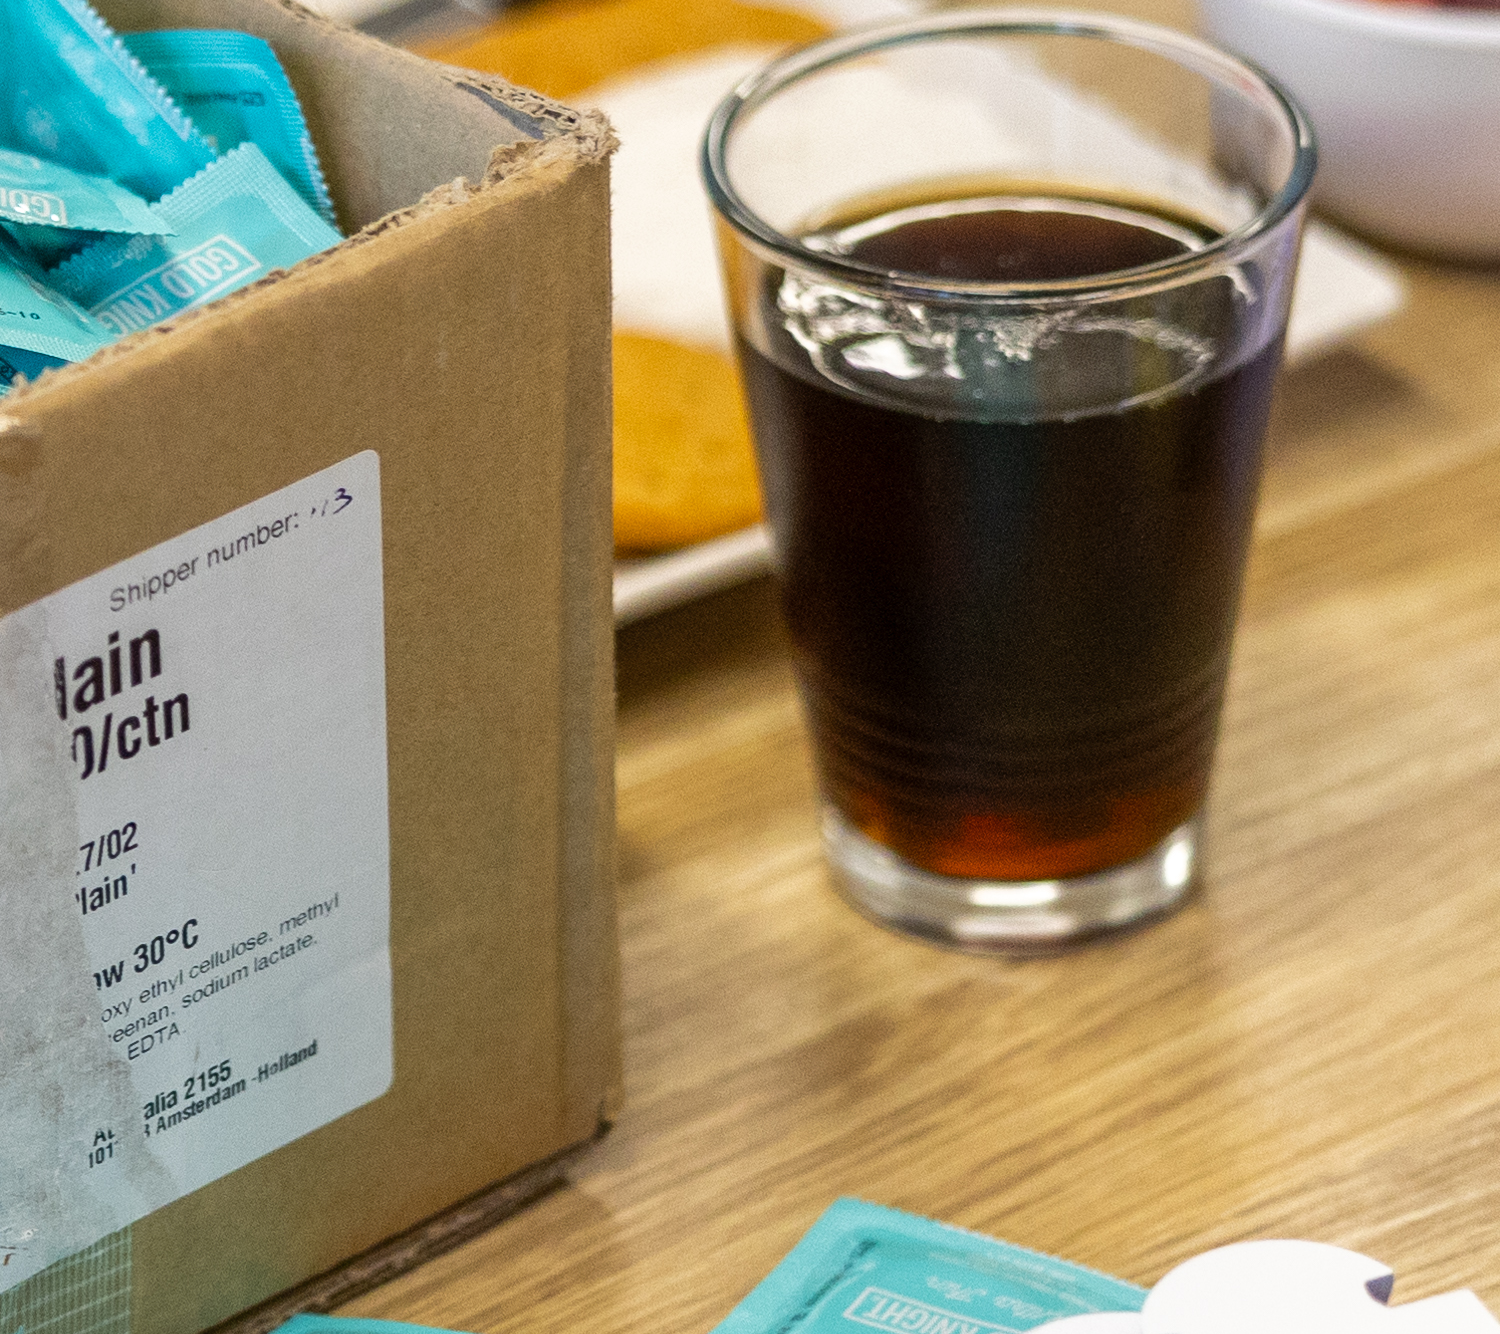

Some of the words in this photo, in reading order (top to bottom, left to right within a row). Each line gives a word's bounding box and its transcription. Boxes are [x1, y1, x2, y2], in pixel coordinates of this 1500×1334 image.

[157, 232, 240, 310] GOLD
[94, 275, 171, 349] KNIG
[109, 551, 199, 618] Shipper
[207, 508, 299, 569] number:
[52, 611, 162, 724] lain
[70, 677, 191, 785] 0/ctn
[133, 916, 199, 975] 30°C
[139, 968, 183, 1007] ethyl
[279, 892, 339, 938] methyl
[182, 962, 248, 1010] sodium
[156, 1075, 246, 1134] Amsterdam
[183, 1058, 231, 1101] 2155
